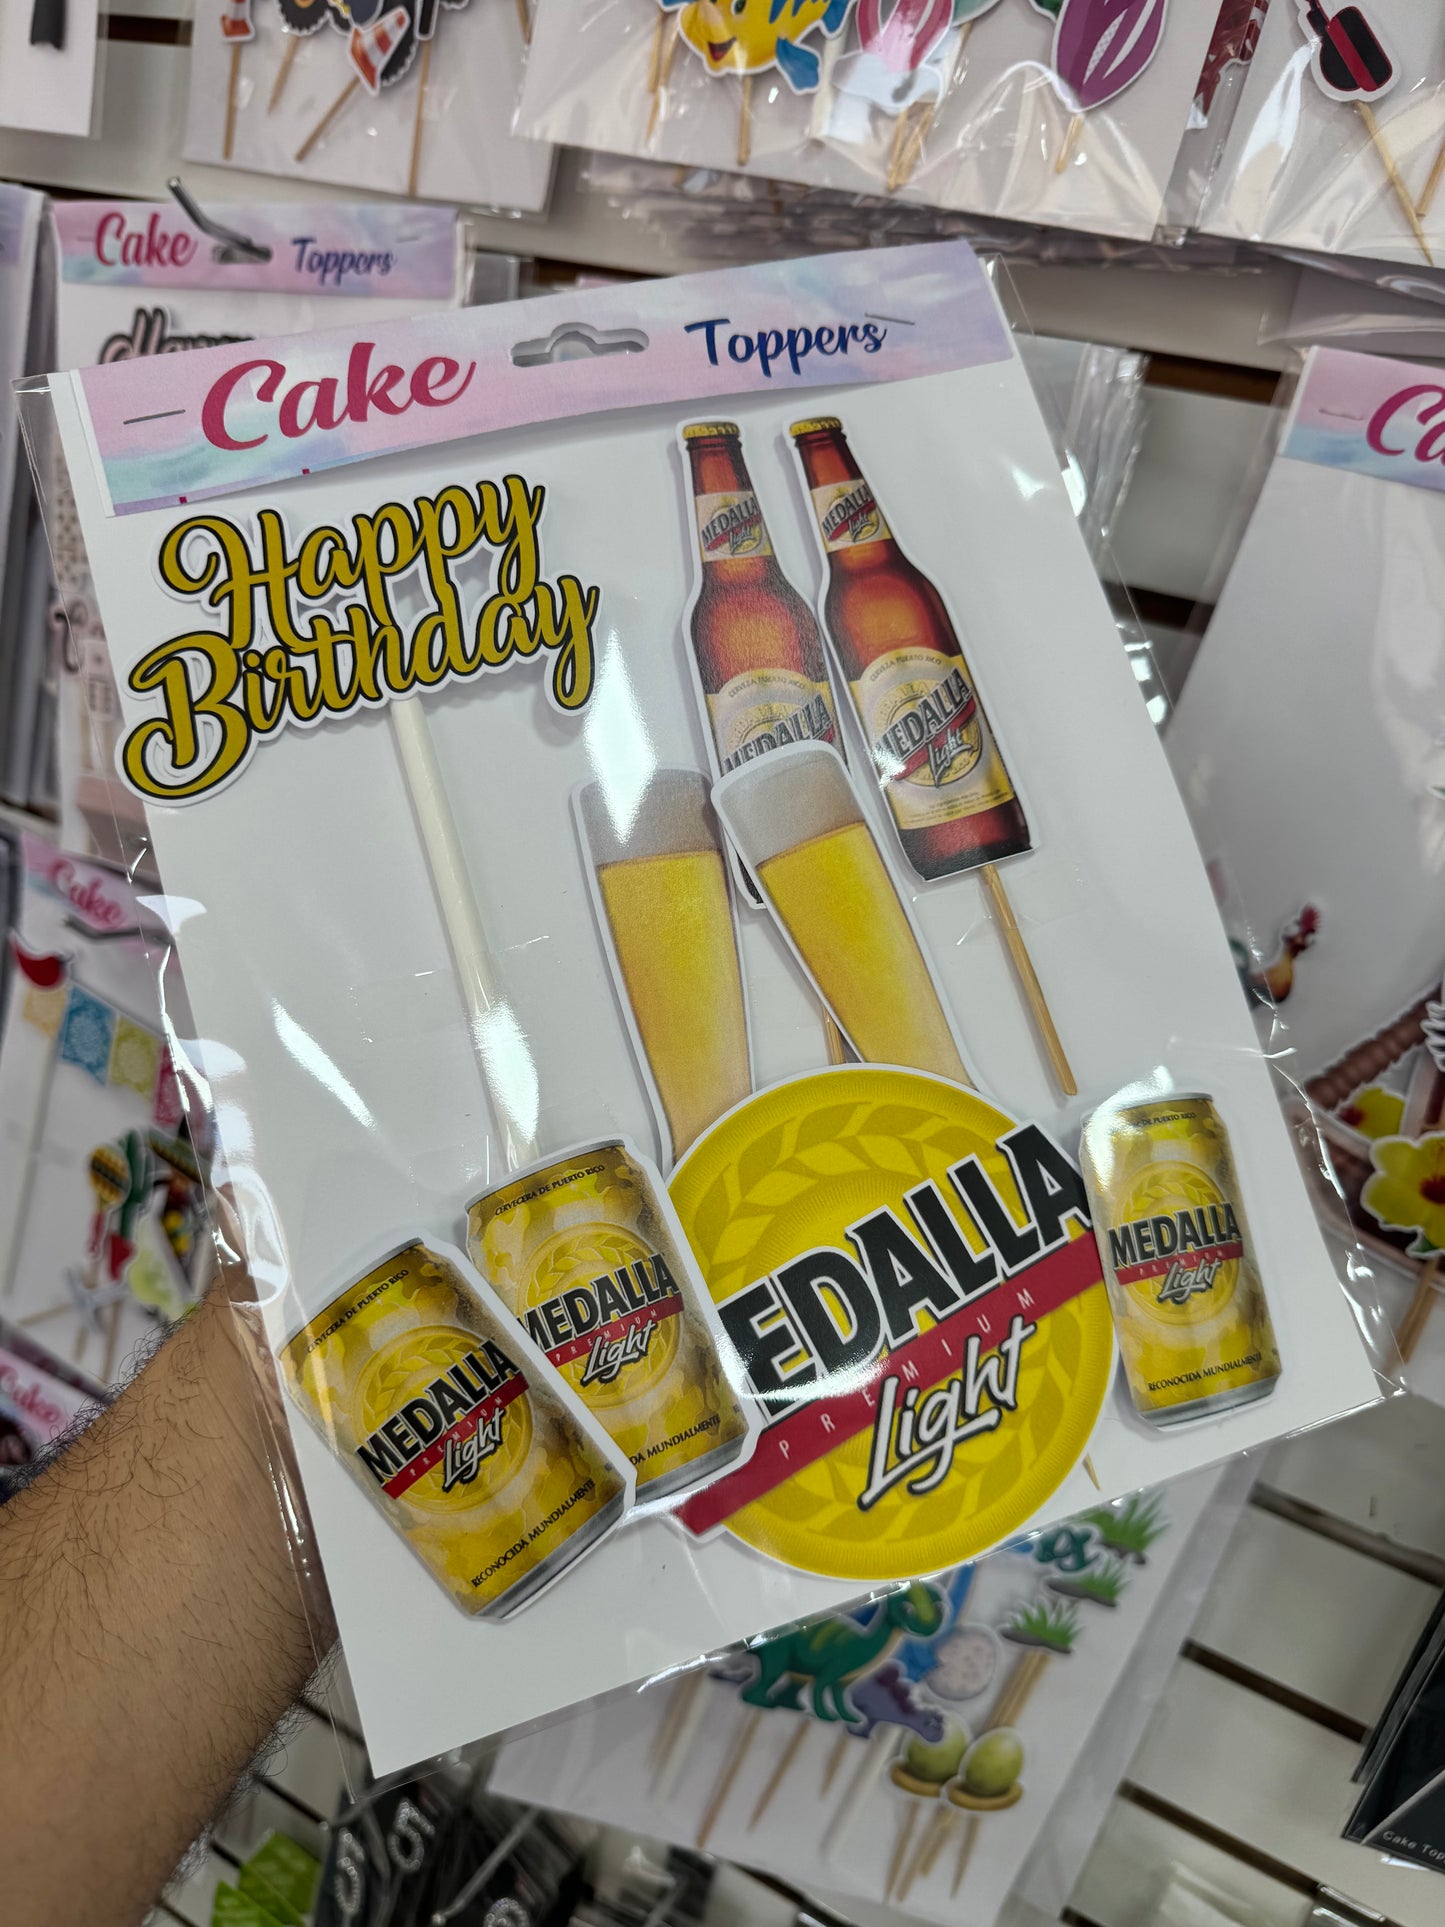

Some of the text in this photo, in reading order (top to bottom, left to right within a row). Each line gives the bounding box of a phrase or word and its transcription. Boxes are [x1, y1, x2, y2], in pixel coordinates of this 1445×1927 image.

[96, 212, 396, 285] Cake Toppers
[202, 318, 887, 451] Cake Toppers
[702, 496, 761, 545] MEDALLA
[822, 484, 873, 535] MEDALLA
[158, 474, 546, 654] Happy
[122, 575, 600, 800] Birthday
[927, 727, 971, 788] Light
[494, 1164, 606, 1216] CERVECERA DE PUERTO RICO
[1107, 1202, 1242, 1271] MEDALLA
[356, 1282, 390, 1309] PUERTO
[388, 1269, 409, 1285] RICO
[1156, 1257, 1222, 1305] Light
[555, 1308, 658, 1362] PREMIUM
[581, 1319, 657, 1387] Light
[778, 1287, 1035, 1461] PREMIUM
[1148, 1351, 1263, 1392] RECONOCIDA MUNDIALMENTE
[356, 1338, 522, 1487] MEDALLA
[409, 1396, 503, 1477] PREMIUM
[646, 1413, 721, 1458] MUNDIALMENTE
[857, 1314, 1037, 1511] Light
[442, 1407, 506, 1493] Light
[471, 1478, 597, 1588] RECONOCIDA MUNDIALMENTE
[1383, 1830, 1418, 1849] Cake
